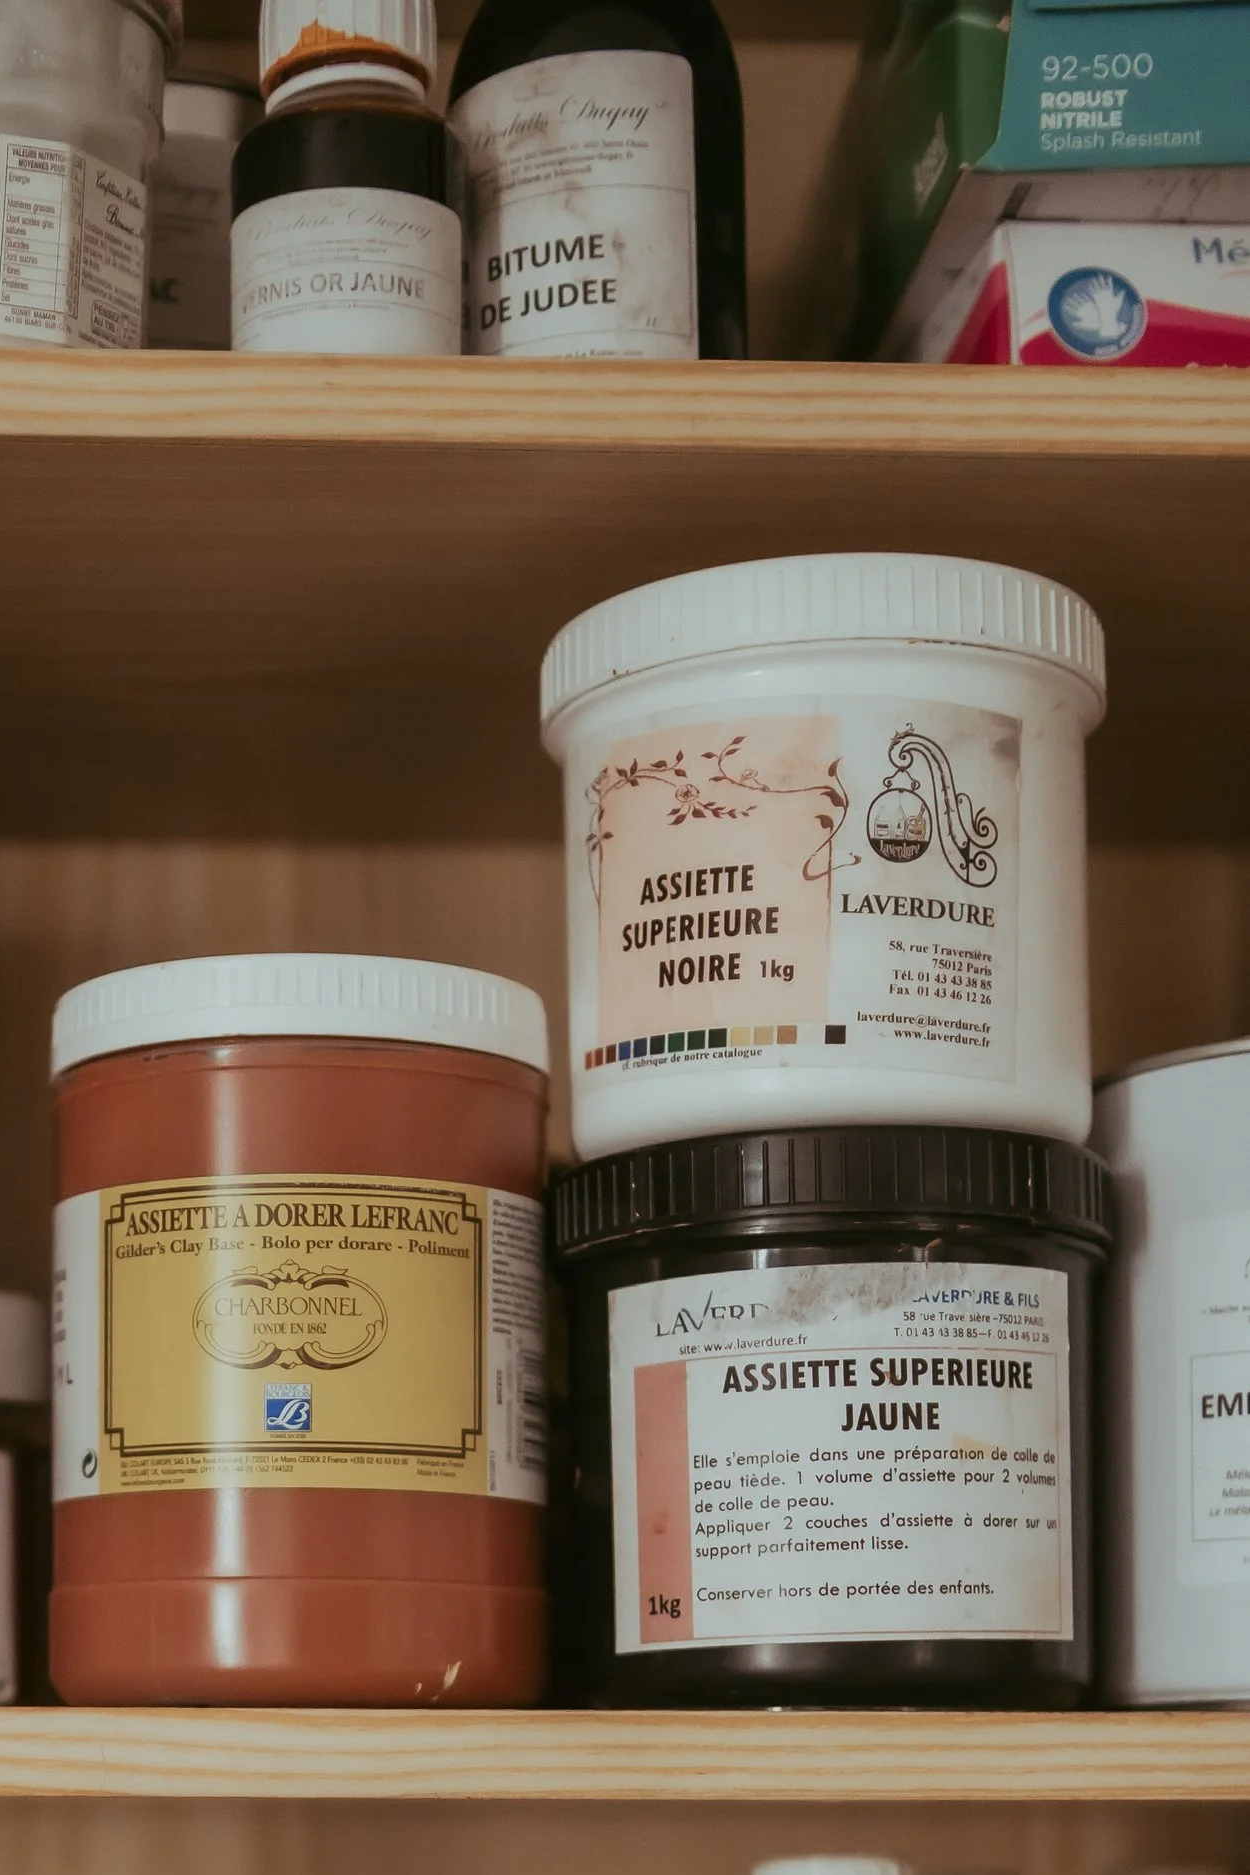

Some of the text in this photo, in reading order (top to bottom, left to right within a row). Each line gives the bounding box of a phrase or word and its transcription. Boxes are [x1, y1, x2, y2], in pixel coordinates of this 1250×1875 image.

[1042, 53, 1154, 82] 92-500
[1040, 89, 1128, 109] ROBUST
[1040, 111, 1123, 130] NITRILE
[1040, 130, 1202, 153] Splash Resistant
[487, 232, 605, 283] BITUME
[310, 271, 343, 294] OR
[350, 273, 426, 300] JAUNE
[480, 277, 617, 332] DE JUDEE
[879, 839, 921, 860] Laverdure
[640, 864, 754, 906] ASSIETTE
[840, 893, 995, 928] LAVERDURE
[622, 906, 779, 952] SUPERIEURE
[889, 940, 993, 963] 58, rue Traversière
[658, 953, 795, 988] NOIRE 1kg
[932, 958, 993, 977] 75012 Paris
[918, 971, 930, 983] 01
[934, 973, 947, 985] 43
[951, 974, 963, 986] 43
[966, 976, 978, 989] 38
[980, 978, 992, 991] 85
[889, 983, 992, 1005] Fax 01 43 46 12 26
[857, 1011, 992, 1034] laverdure@laverdure.fr
[894, 1028, 991, 1049] www.laverdure.fr
[632, 1047, 763, 1070] rubrique de notre catalogue
[125, 1202, 459, 1237] ASSIETTE A DORER LEFRANC
[115, 1234, 471, 1260] Gilder's Clay Base Bolo per dorare Poliment
[214, 1296, 363, 1317] CHARBONNEL
[1003, 1292, 1014, 1306] &
[1017, 1292, 1040, 1309] FILS
[290, 1321, 327, 1335] EN 1862
[903, 1311, 991, 1324] 58 Travesière
[679, 1334, 808, 1356] site: www.laverdure.fr
[722, 1356, 1033, 1394] ASSIETTE SUPERIEURE
[841, 1402, 941, 1432] JAUNE
[693, 1445, 1056, 1469] Elle s'emploie dans une préparation de colle de
[694, 1478, 731, 1494] peau
[740, 1472, 786, 1488] tiède.
[816, 1469, 873, 1484] volume
[882, 1467, 956, 1483] d'assiette
[964, 1471, 995, 1486] pour
[1002, 1468, 1010, 1483] 2
[1017, 1470, 1056, 1487] volumes
[695, 1494, 835, 1514] de colle de peau.
[695, 1518, 771, 1538] Appliquer
[783, 1516, 793, 1530] 2
[805, 1513, 868, 1530] couches
[880, 1512, 954, 1528] d'assiette
[964, 1513, 973, 1527] à
[983, 1512, 1018, 1528] dorer
[1025, 1518, 1040, 1529] sur
[695, 1535, 909, 1560] support parfaitement lisse.
[696, 1579, 995, 1602] Conserver hors de portée des enfants.
[648, 1594, 682, 1619] 1kg
